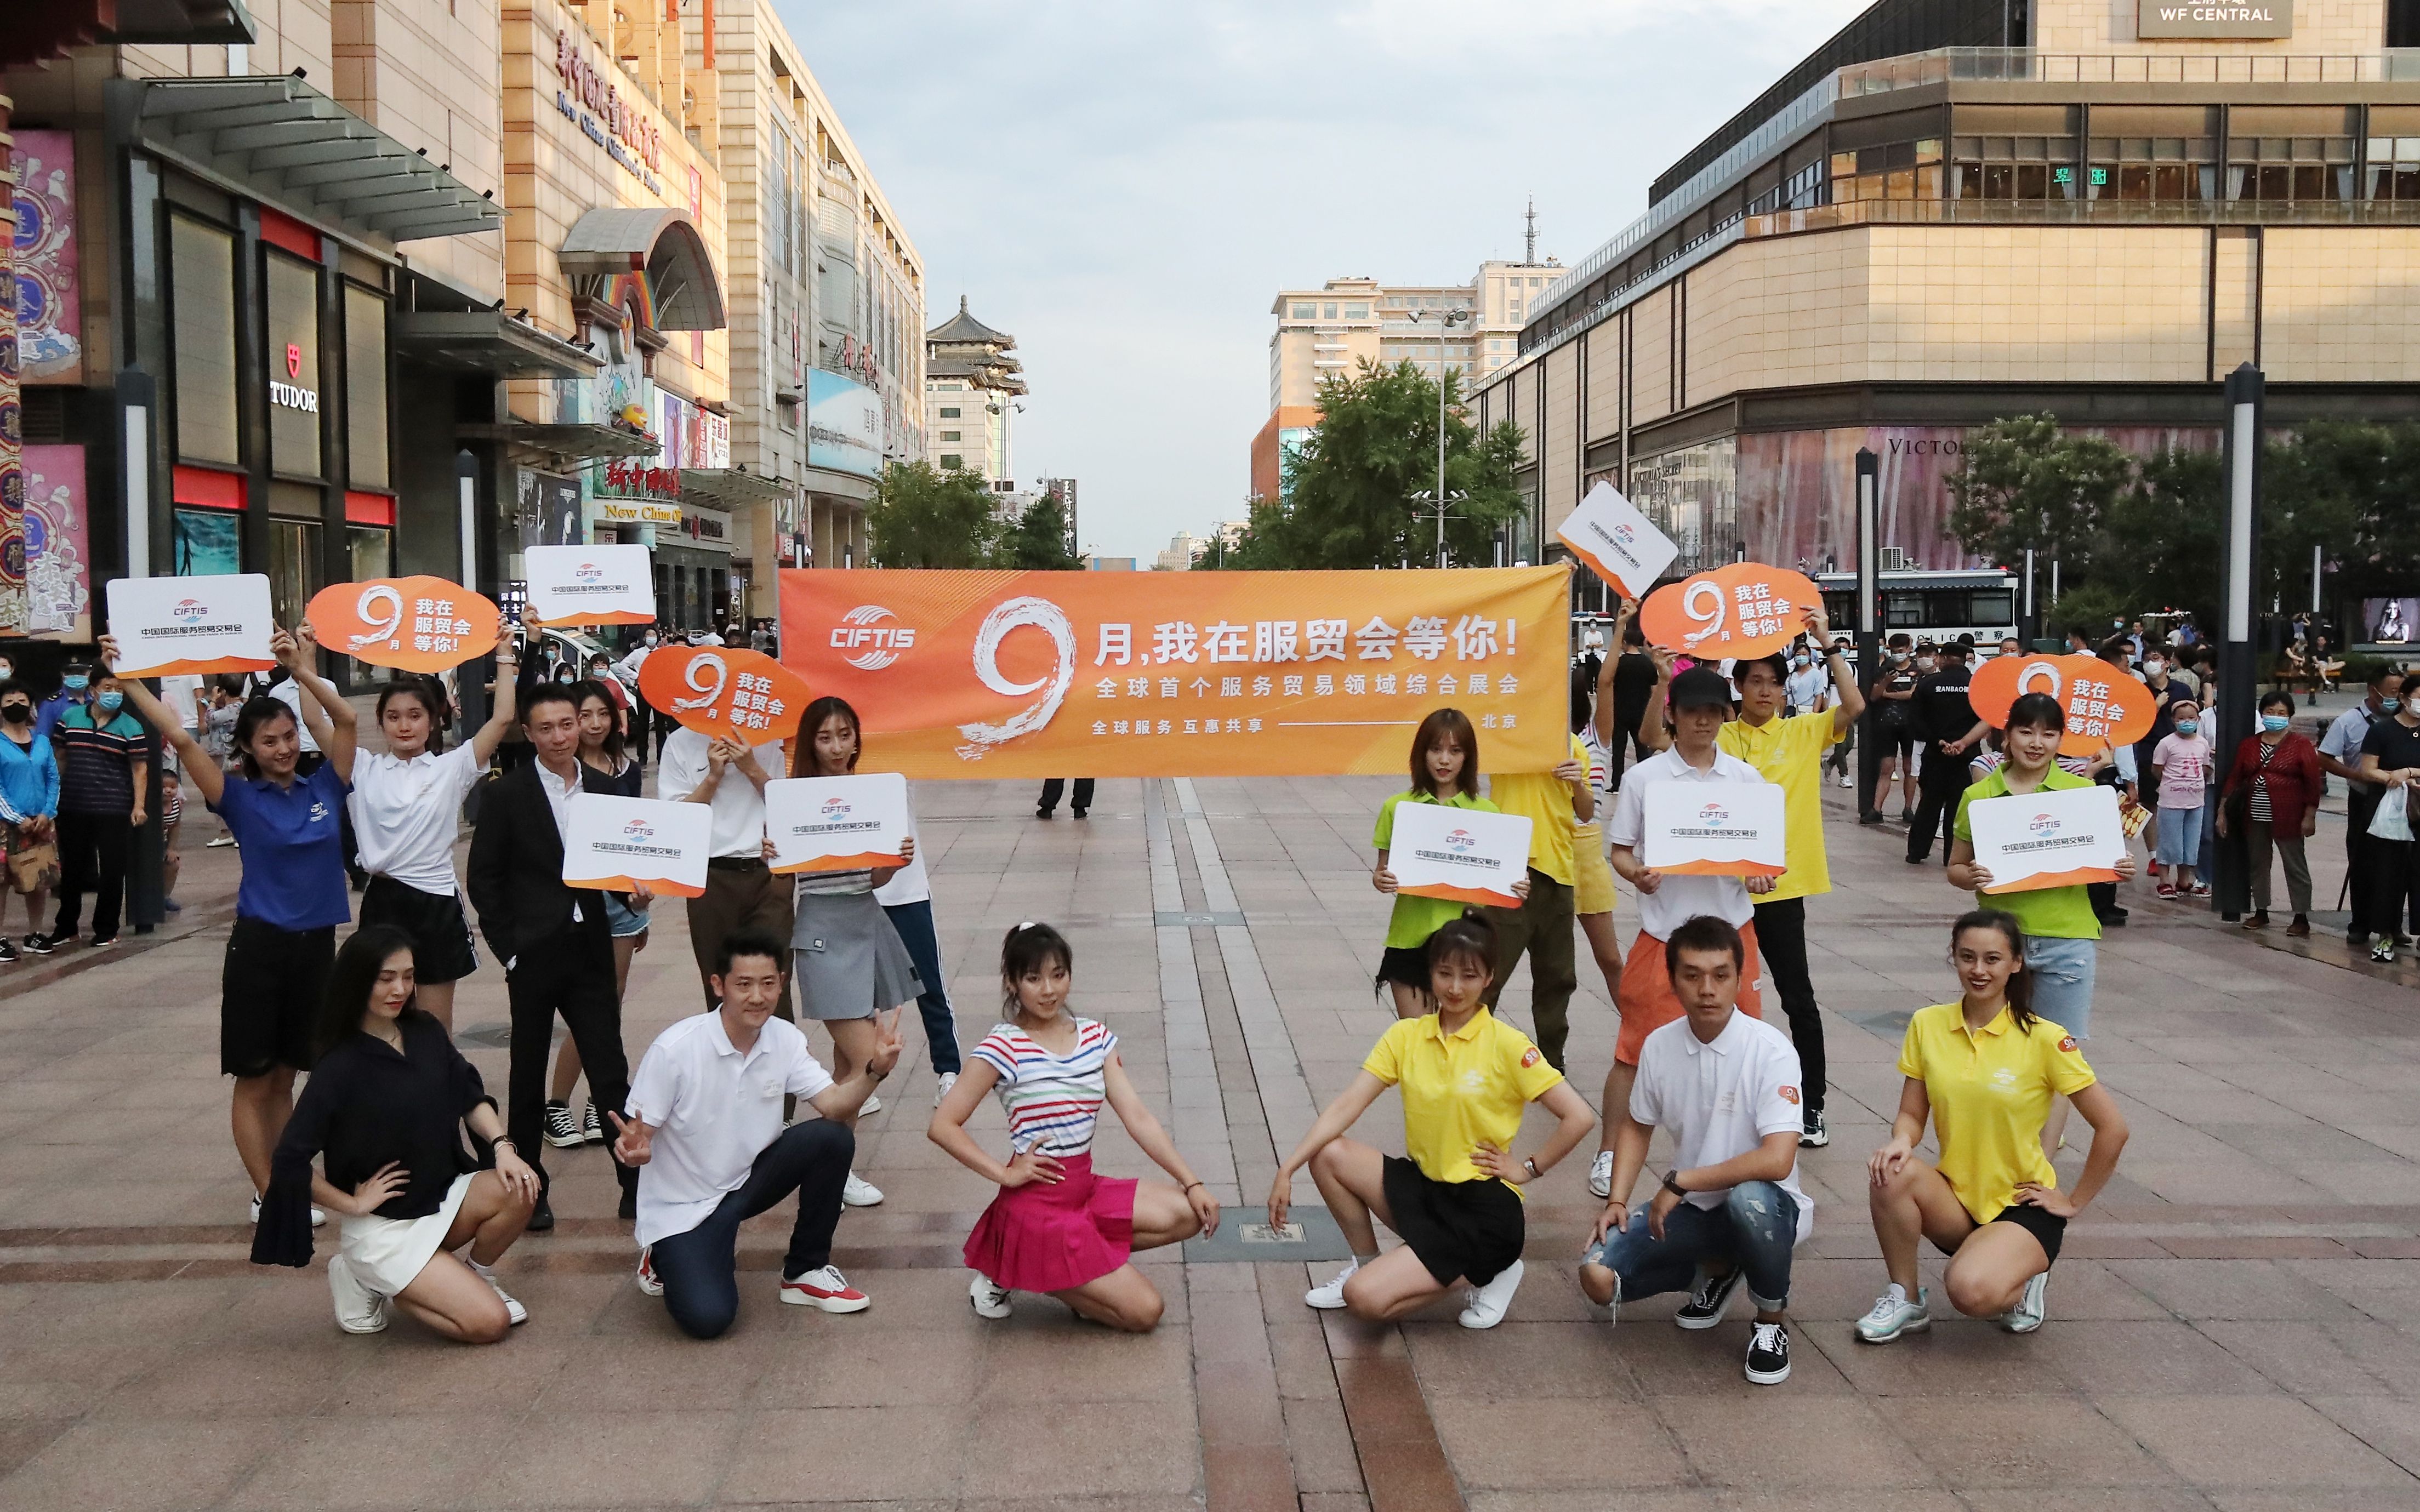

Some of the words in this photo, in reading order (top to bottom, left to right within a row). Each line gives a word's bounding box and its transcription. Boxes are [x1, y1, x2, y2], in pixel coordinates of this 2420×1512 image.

[2160, 8, 2188, 21] WF
[2193, 8, 2273, 21] CENTRAL
[270, 380, 318, 413] TUDOR
[605, 505, 637, 518] New
[1615, 526, 1634, 543] CIFTIS
[1734, 583, 1771, 602] 我在
[174, 607, 208, 615] CIFTIS
[415, 598, 454, 616] 我在
[1683, 580, 1726, 649] 9
[1721, 631, 1730, 641] 月
[1738, 598, 1790, 620] 服贸会
[347, 585, 403, 651] 9
[389, 640, 400, 651] 月
[414, 617, 472, 636] 服贸会
[1742, 618, 1783, 637] 等你!
[141, 624, 242, 636] 中国国际服务贸易交易会
[829, 628, 916, 648] CIFTIS
[1974, 630, 2003, 641] 警察
[414, 635, 458, 653] 等你!
[670, 652, 728, 714] 9
[707, 708, 718, 720] 月
[737, 672, 773, 694] 我在
[954, 596, 1077, 761] 9
[1095, 672, 1519, 699] 全球首个服务贸易领域综合展会
[2073, 678, 2110, 700] 我在
[732, 689, 785, 716] 服贸会
[2069, 697, 2125, 722] 服贸会
[730, 707, 771, 731] 等你!
[1091, 719, 1172, 735] 全球服务
[1182, 718, 1263, 734] 互惠共享
[1482, 713, 1517, 729] 北京
[2066, 717, 2110, 740] 等你!
[822, 805, 851, 814] CIFTIS
[624, 826, 654, 835] CIFTIS
[793, 821, 880, 833] 中国国际服务贸易交易会
[1671, 828, 1757, 837] 中国国际服务贸易交易会
[2030, 820, 2060, 830] CIFTIS
[593, 842, 681, 856] 中国国际服务贸易交易会
[1446, 836, 1476, 846] CIFTIS
[2002, 835, 2094, 852] 中国国际服务贸易交易会
